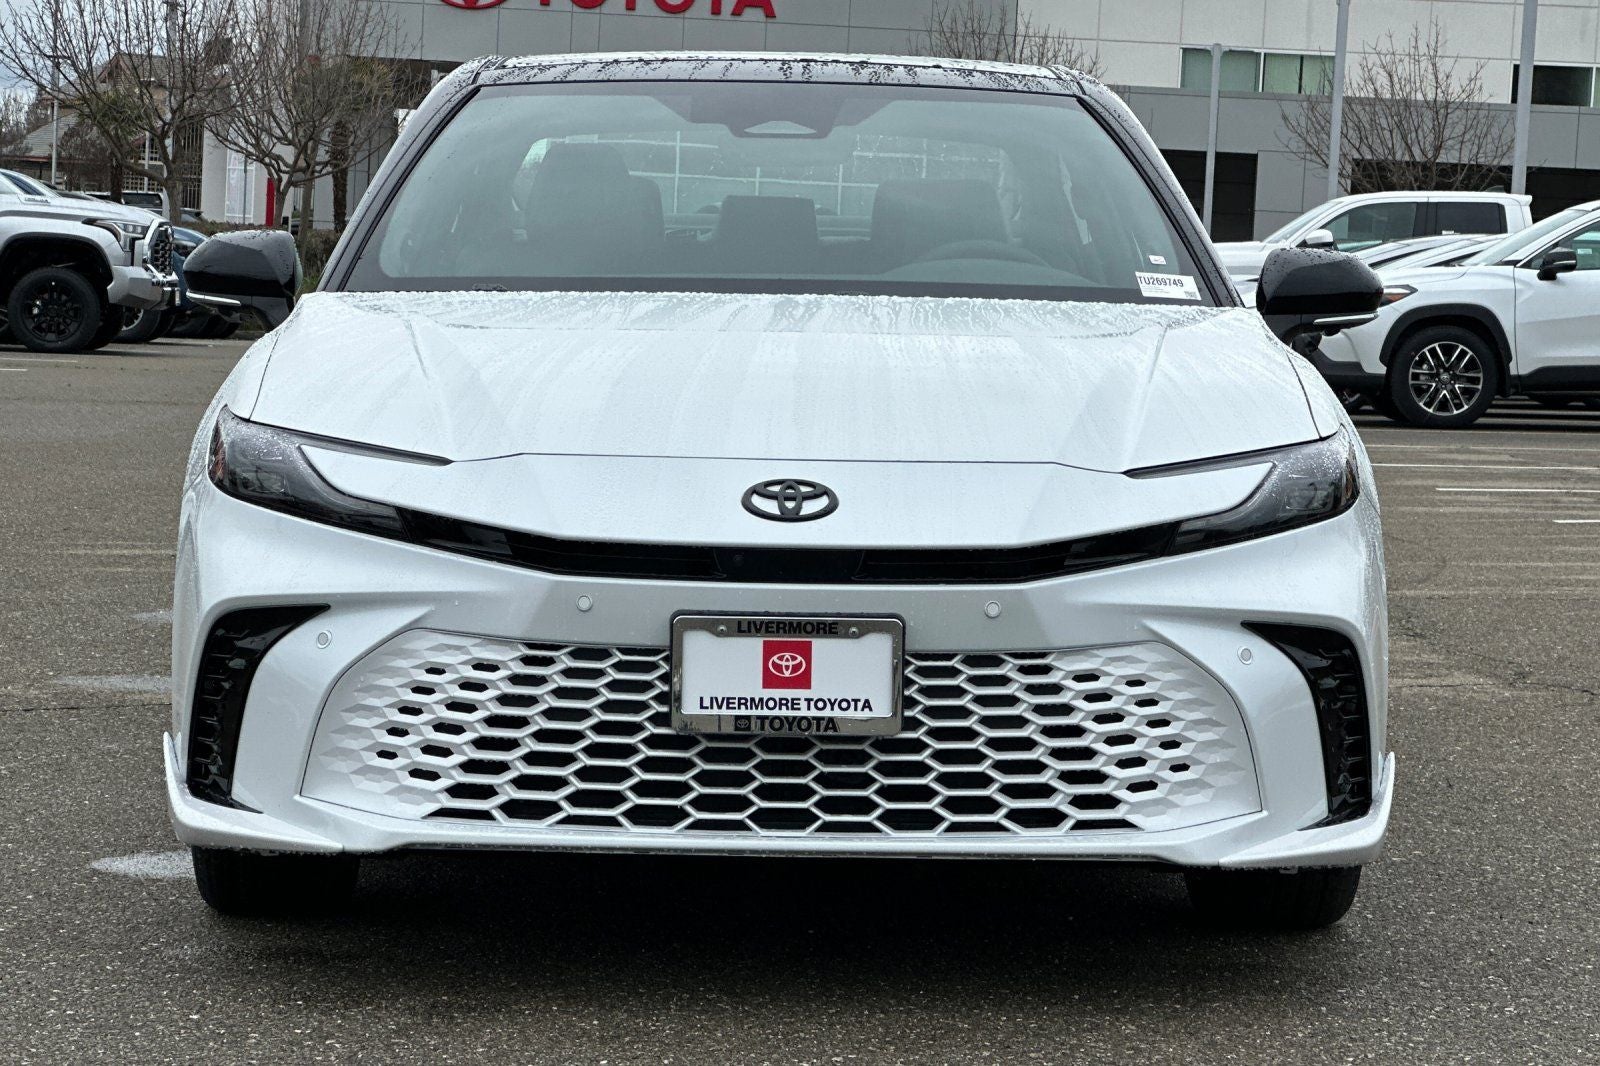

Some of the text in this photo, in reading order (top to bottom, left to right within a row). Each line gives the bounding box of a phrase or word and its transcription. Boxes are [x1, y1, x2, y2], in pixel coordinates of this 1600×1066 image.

[1138, 276, 1184, 287] TU269749
[737, 620, 839, 635] LIVERMORE
[699, 696, 873, 712] LIVERMORE TOYOTA
[756, 716, 839, 732] TOYOTA
